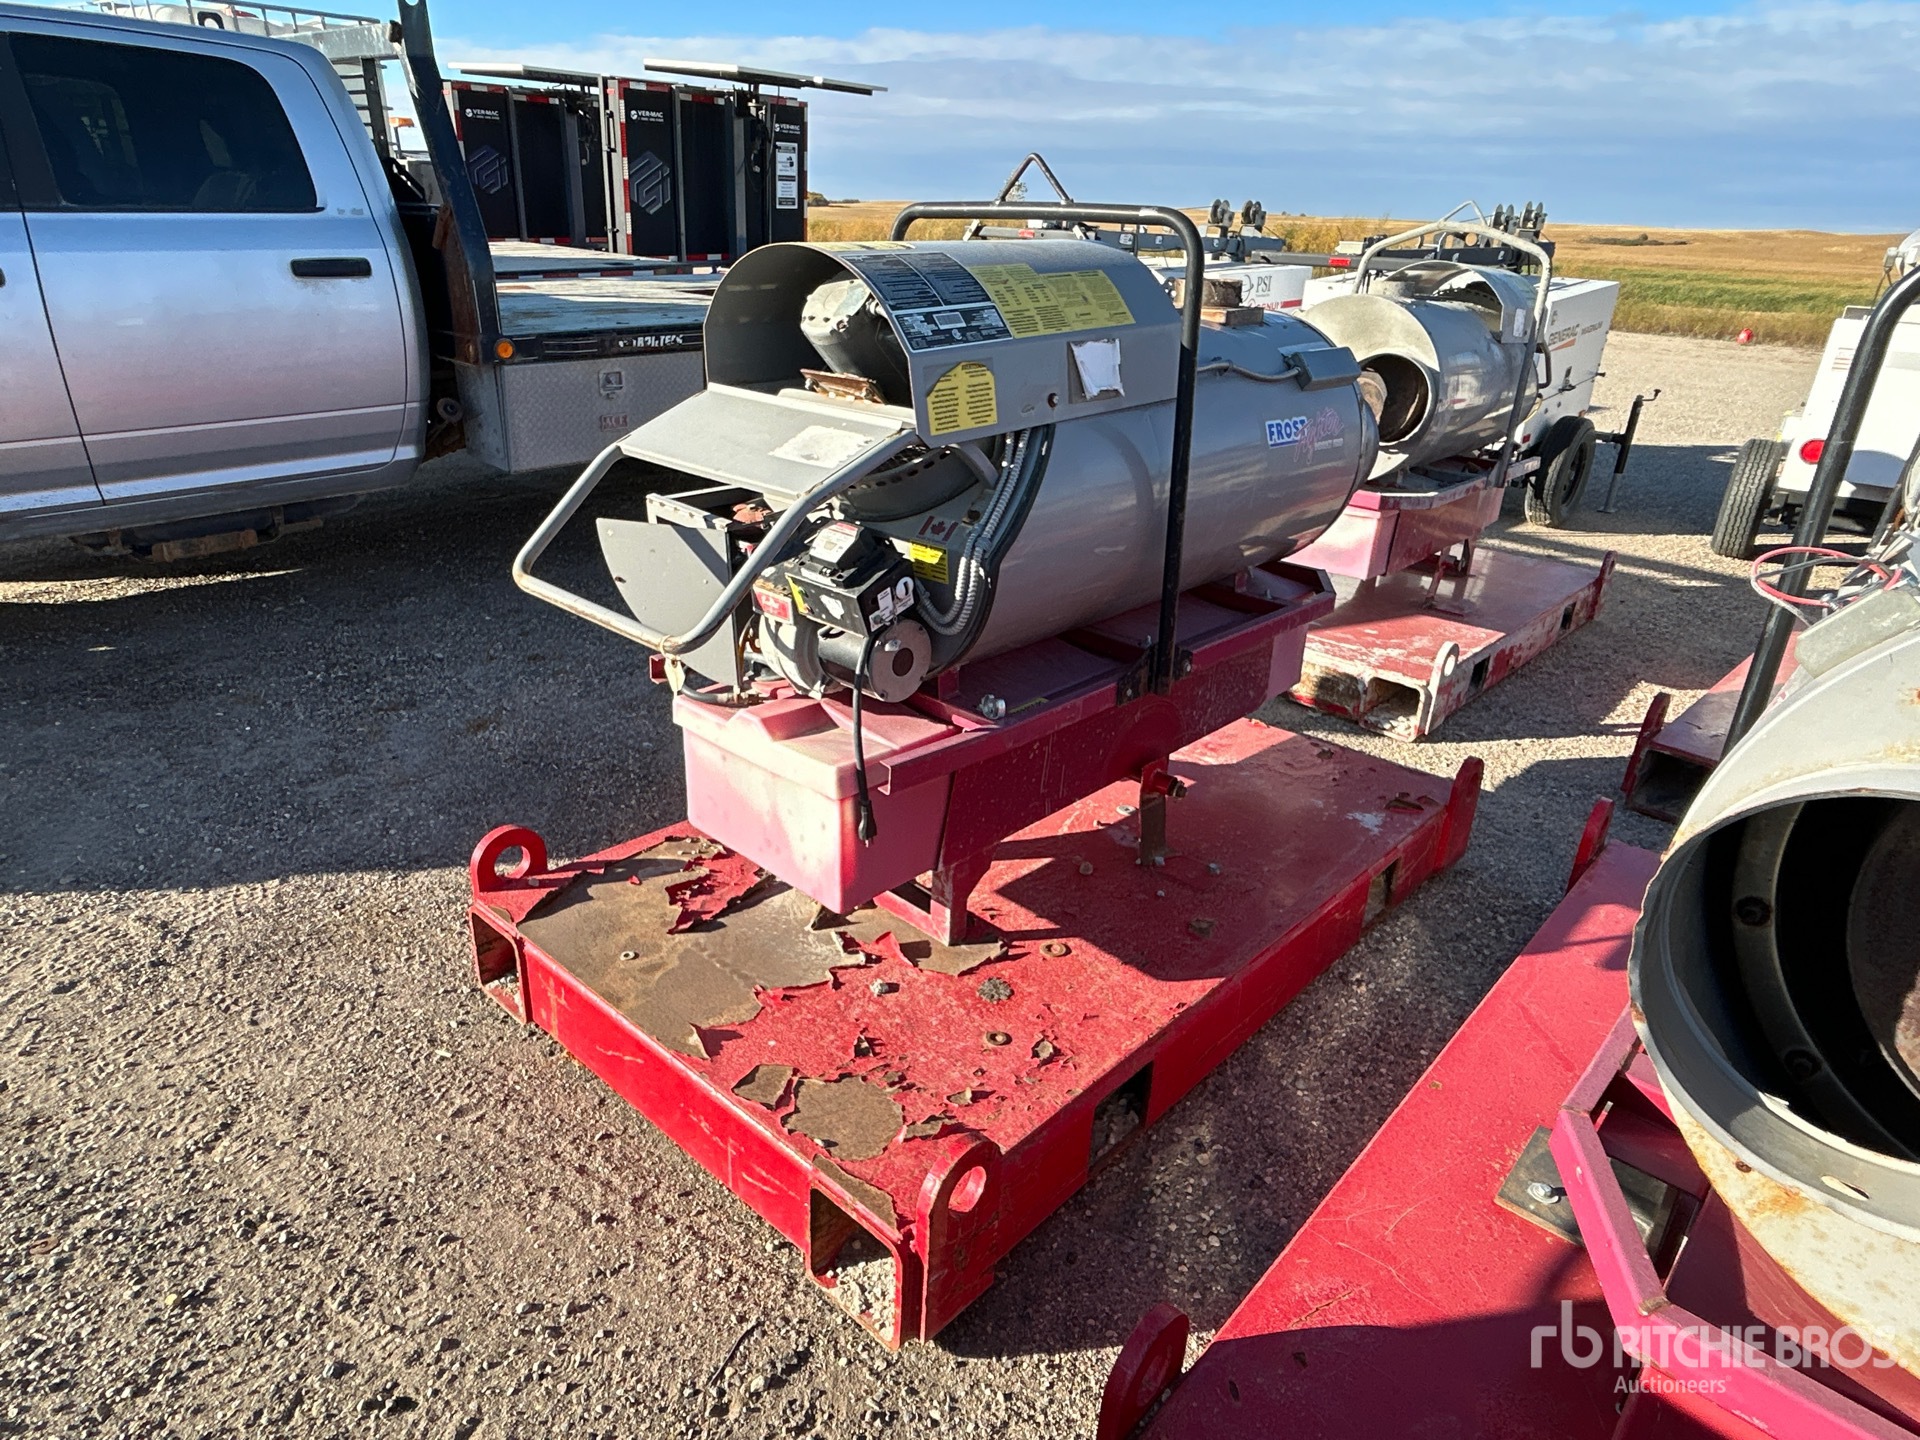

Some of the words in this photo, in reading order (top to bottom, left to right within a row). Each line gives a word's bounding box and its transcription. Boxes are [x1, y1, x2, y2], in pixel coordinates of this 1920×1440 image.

[472, 108, 499, 116] VER-MAC
[638, 109, 664, 118] VER-MAC
[1256, 275, 1272, 293] PSI
[1267, 418, 1307, 442] FROST
